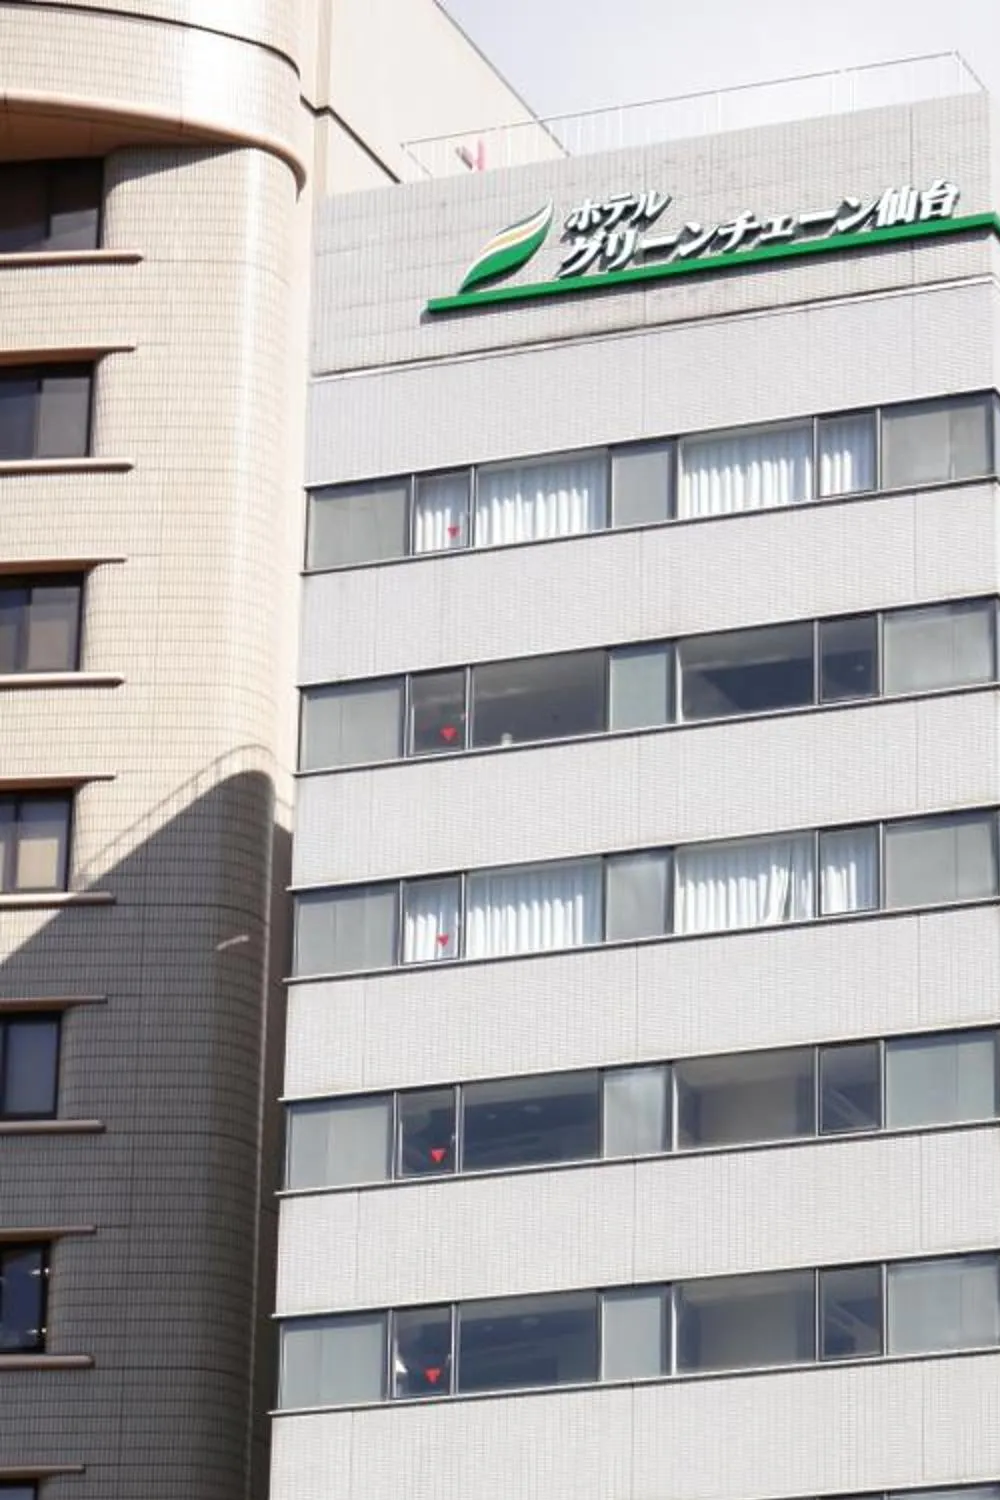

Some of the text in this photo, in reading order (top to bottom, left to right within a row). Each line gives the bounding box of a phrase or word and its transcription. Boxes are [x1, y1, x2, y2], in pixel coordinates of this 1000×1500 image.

[557, 179, 960, 277] グリーンチェーン仙台
[566, 189, 668, 230] ホテル
